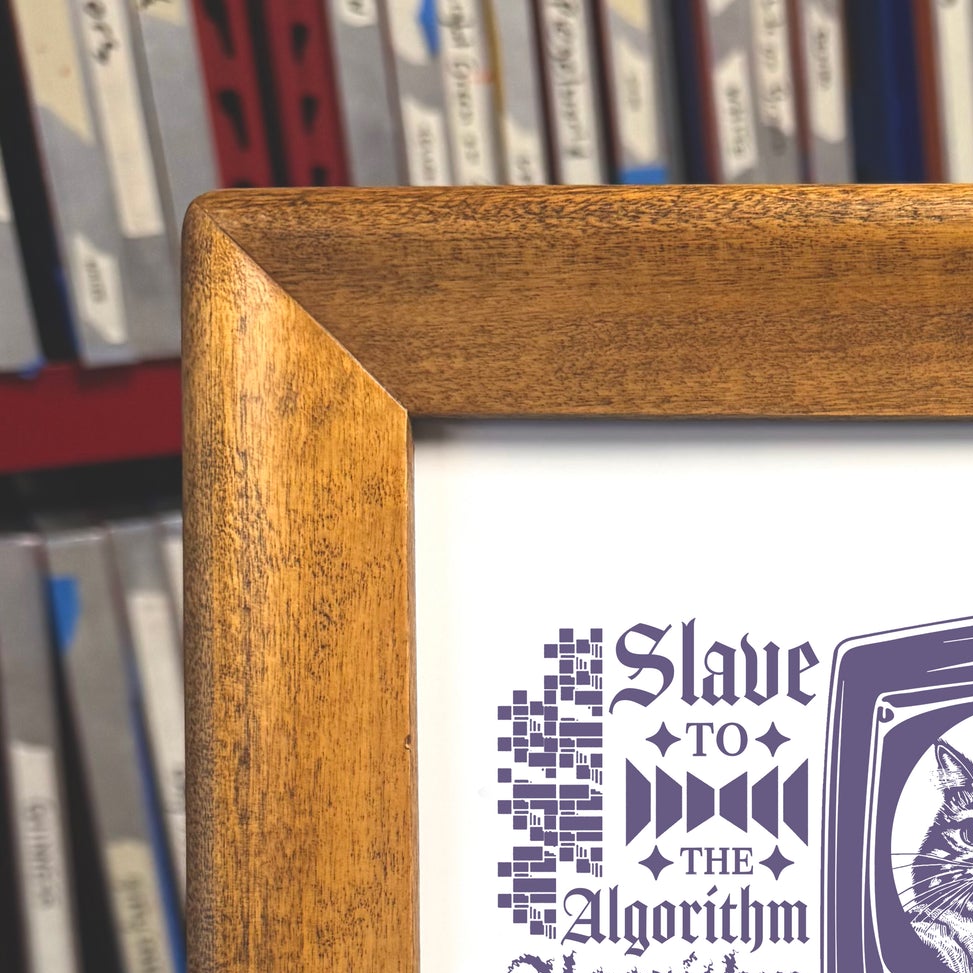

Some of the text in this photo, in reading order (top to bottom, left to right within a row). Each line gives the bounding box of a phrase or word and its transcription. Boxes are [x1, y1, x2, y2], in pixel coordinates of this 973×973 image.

[609, 618, 820, 714] Slave
[685, 722, 749, 757] TO
[679, 847, 754, 875] THE
[561, 885, 810, 957] Algorithm
